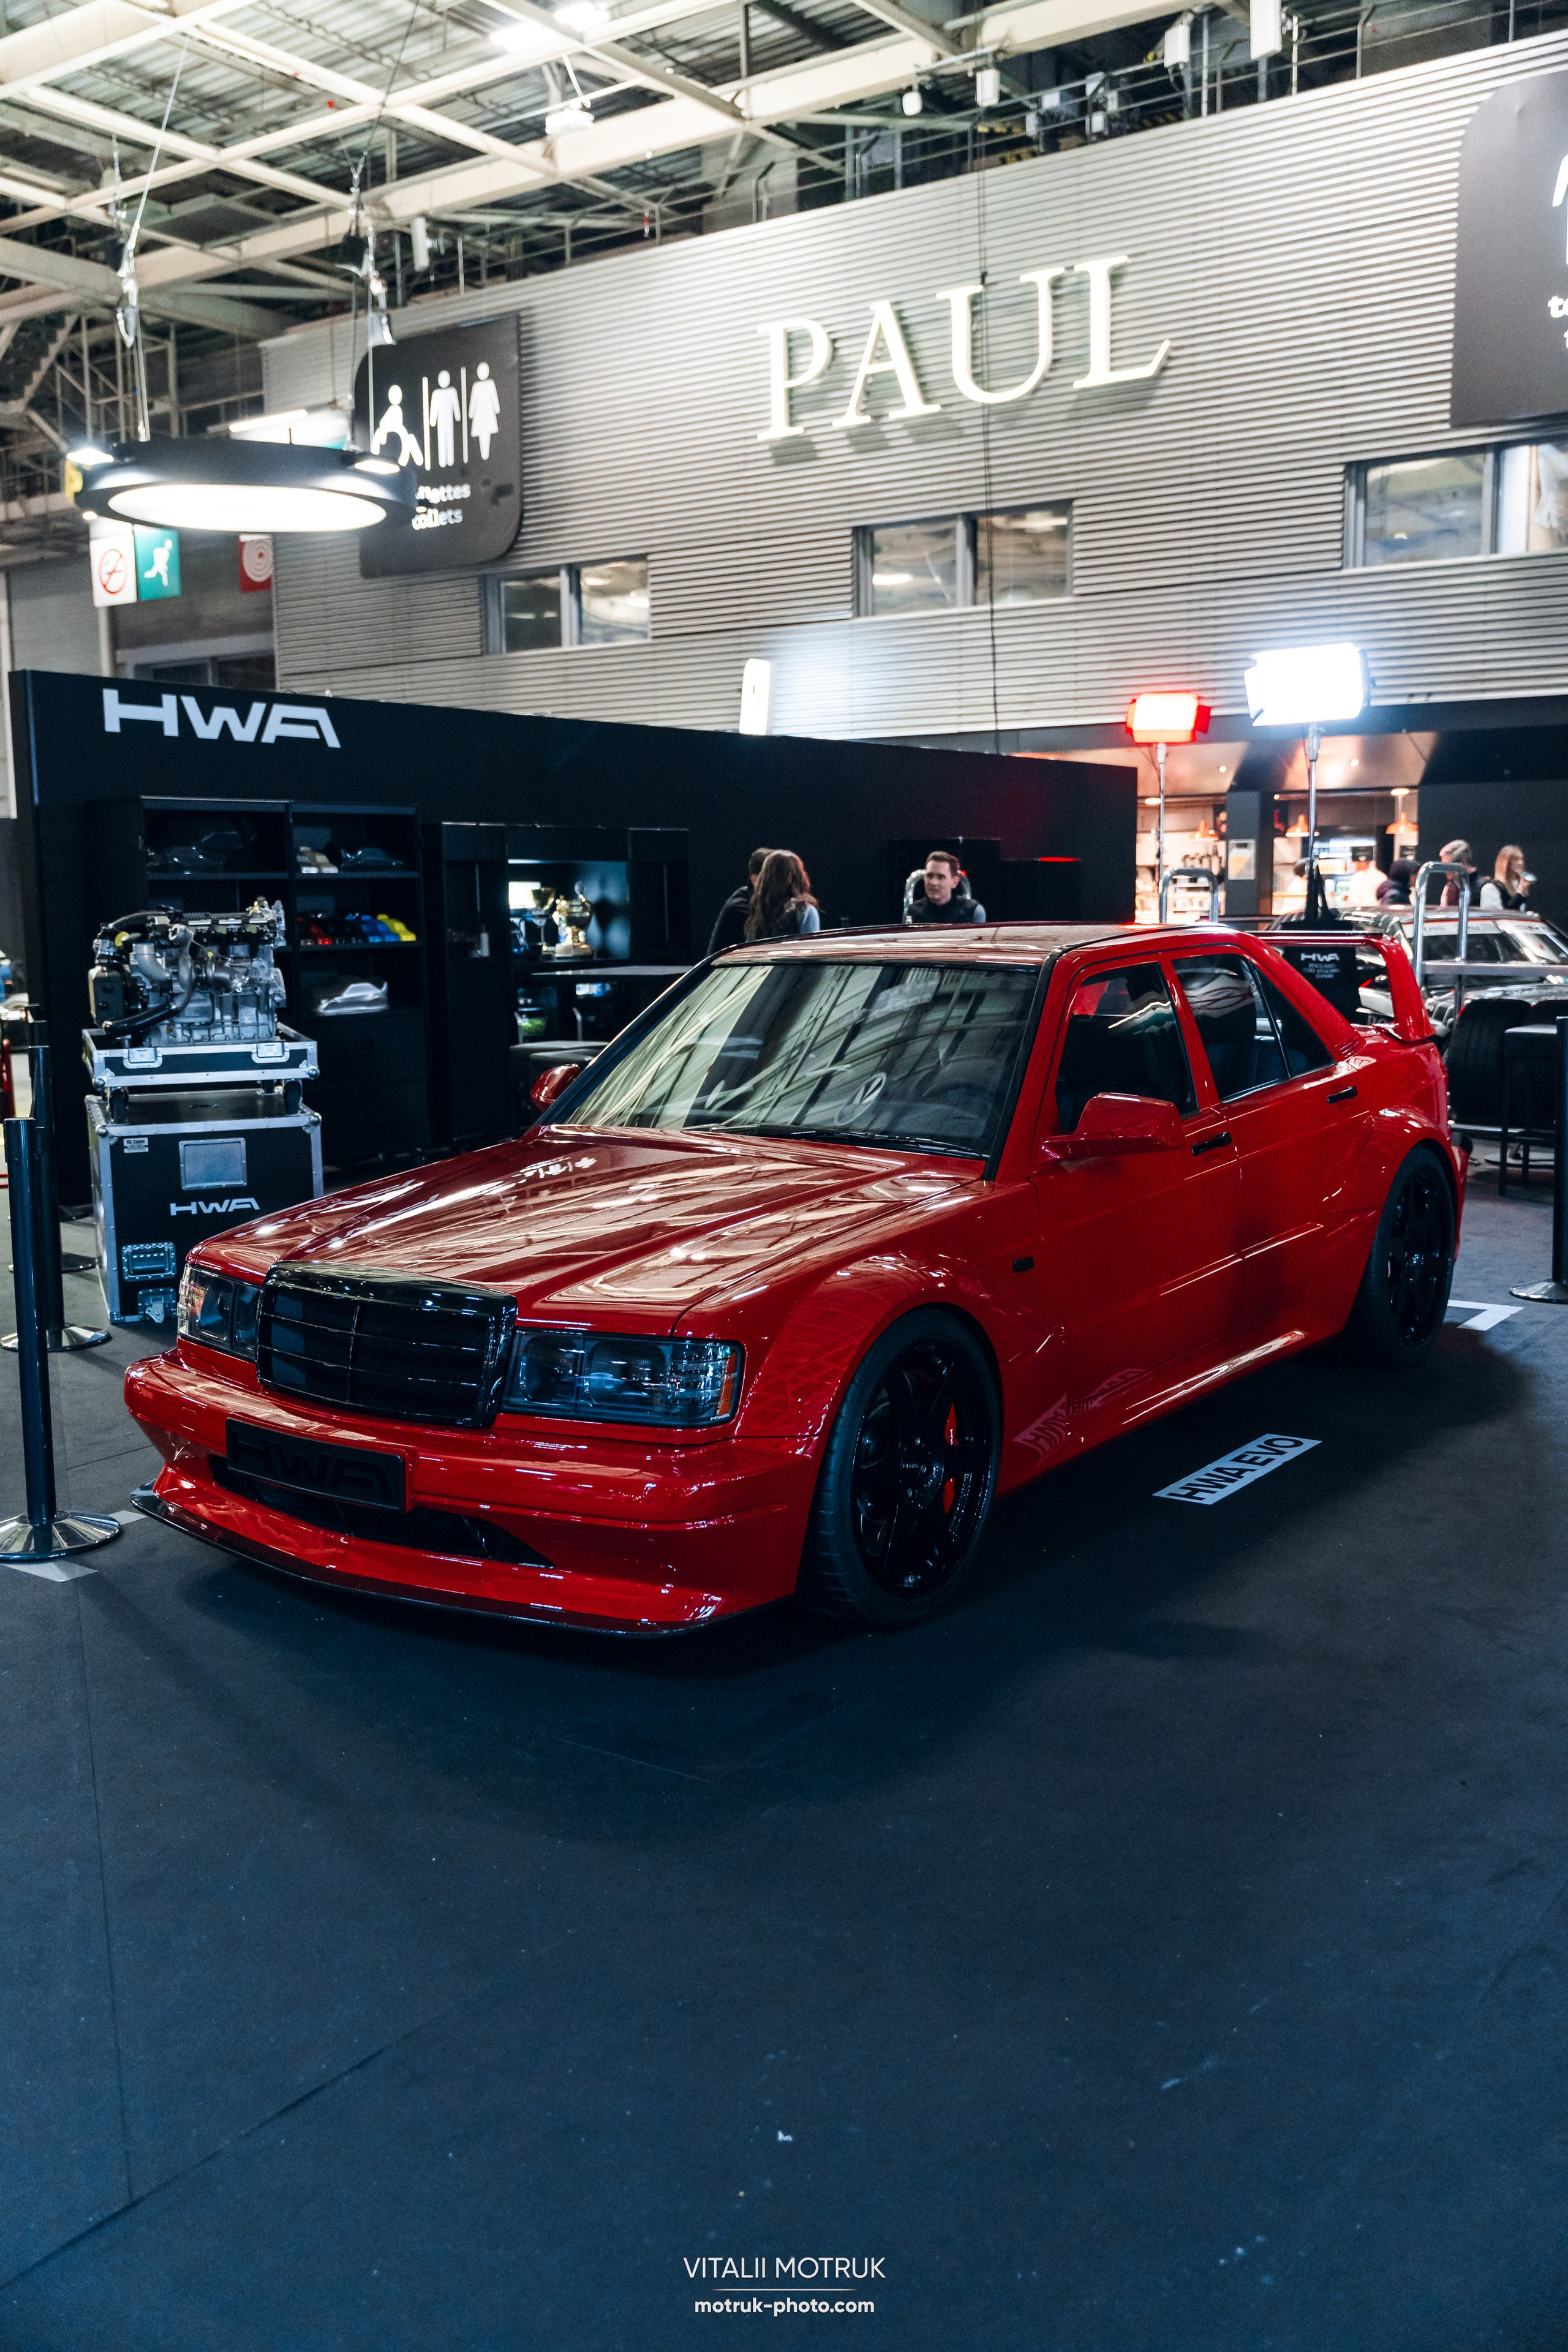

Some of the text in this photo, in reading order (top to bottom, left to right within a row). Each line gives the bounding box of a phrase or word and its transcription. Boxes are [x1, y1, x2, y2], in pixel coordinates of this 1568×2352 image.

[757, 255, 1170, 442] PAUL
[102, 688, 342, 748] HWA
[1300, 952, 1340, 962] HWA
[170, 1197, 260, 1216] HWA
[1167, 1437, 1303, 1501] HWA EVO
